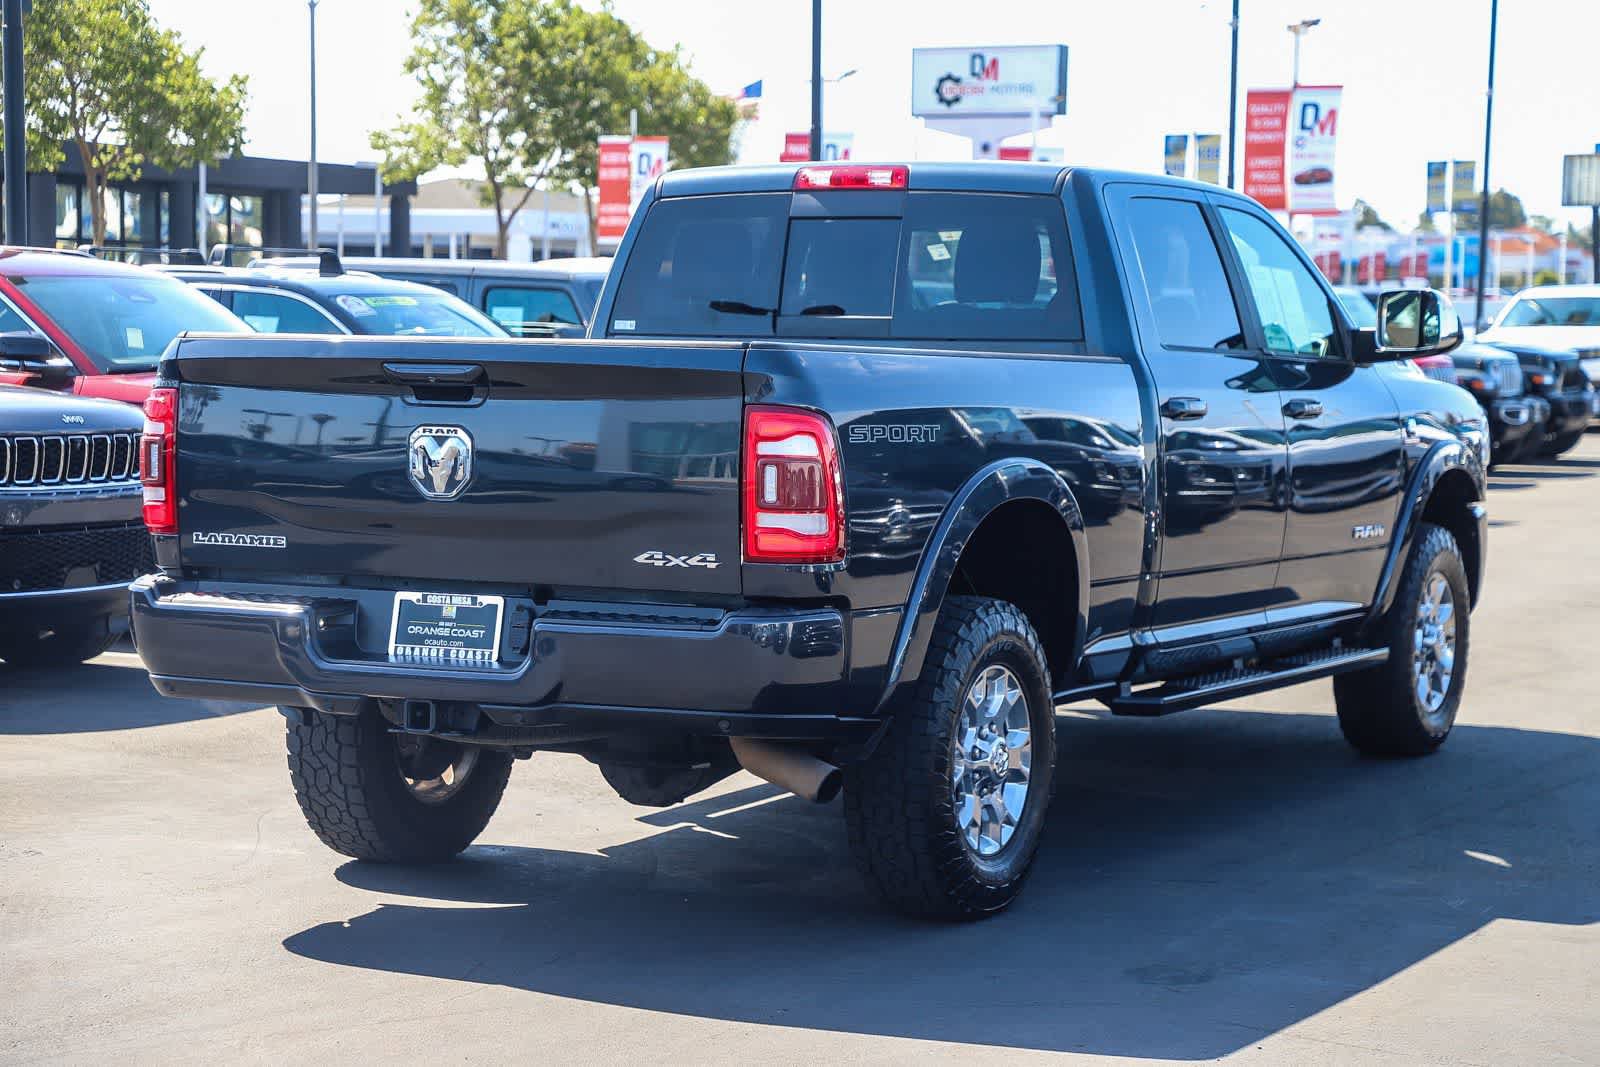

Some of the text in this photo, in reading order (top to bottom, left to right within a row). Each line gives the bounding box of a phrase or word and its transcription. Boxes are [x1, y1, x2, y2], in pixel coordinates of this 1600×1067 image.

[849, 424, 941, 443] SPORT
[193, 532, 286, 548] LARAMIE
[427, 594, 451, 604] COSTA
[407, 625, 486, 639] ORANGE COAST
[424, 639, 464, 648] ocauto.com
[396, 647, 491, 660] ORANGE COAST
